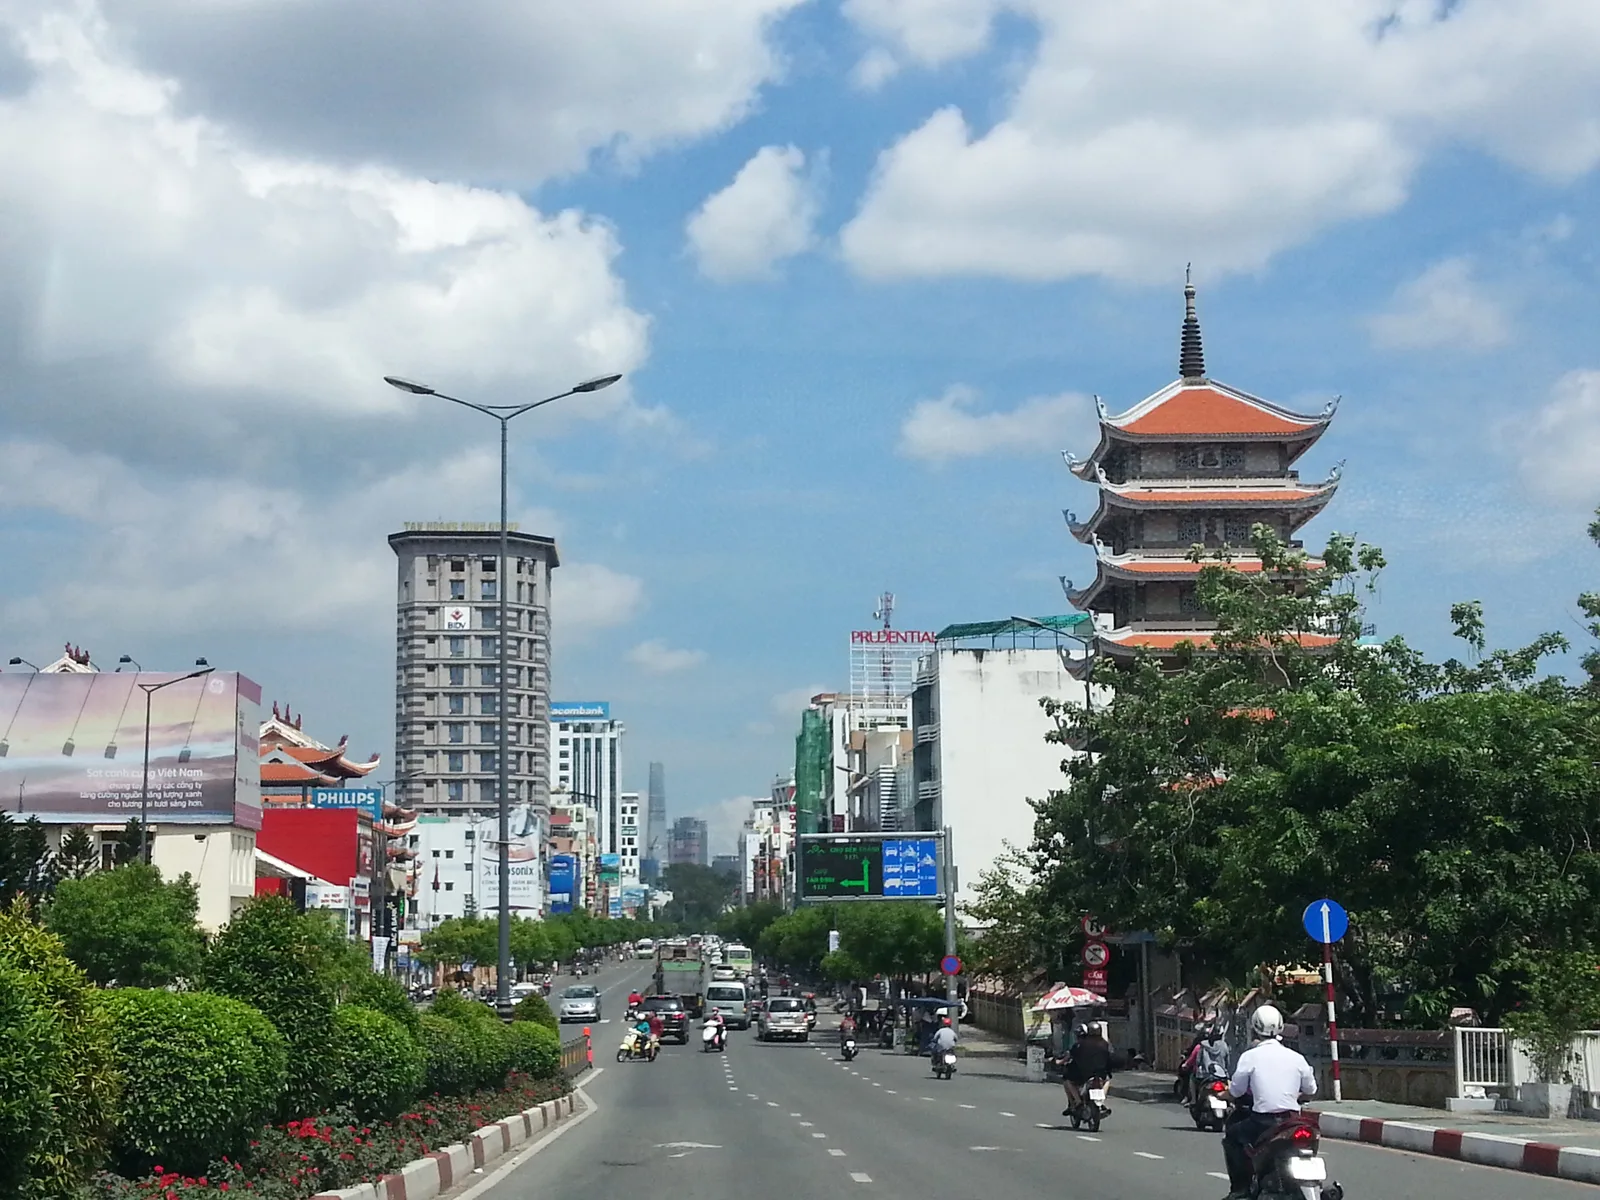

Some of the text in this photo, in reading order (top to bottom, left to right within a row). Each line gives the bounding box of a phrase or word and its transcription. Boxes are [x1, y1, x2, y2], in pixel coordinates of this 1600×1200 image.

[447, 621, 466, 629] BIDV
[551, 705, 604, 715] acombank
[179, 767, 204, 777] Nam
[317, 792, 375, 805] PHILIPS
[107, 800, 121, 808] cho
